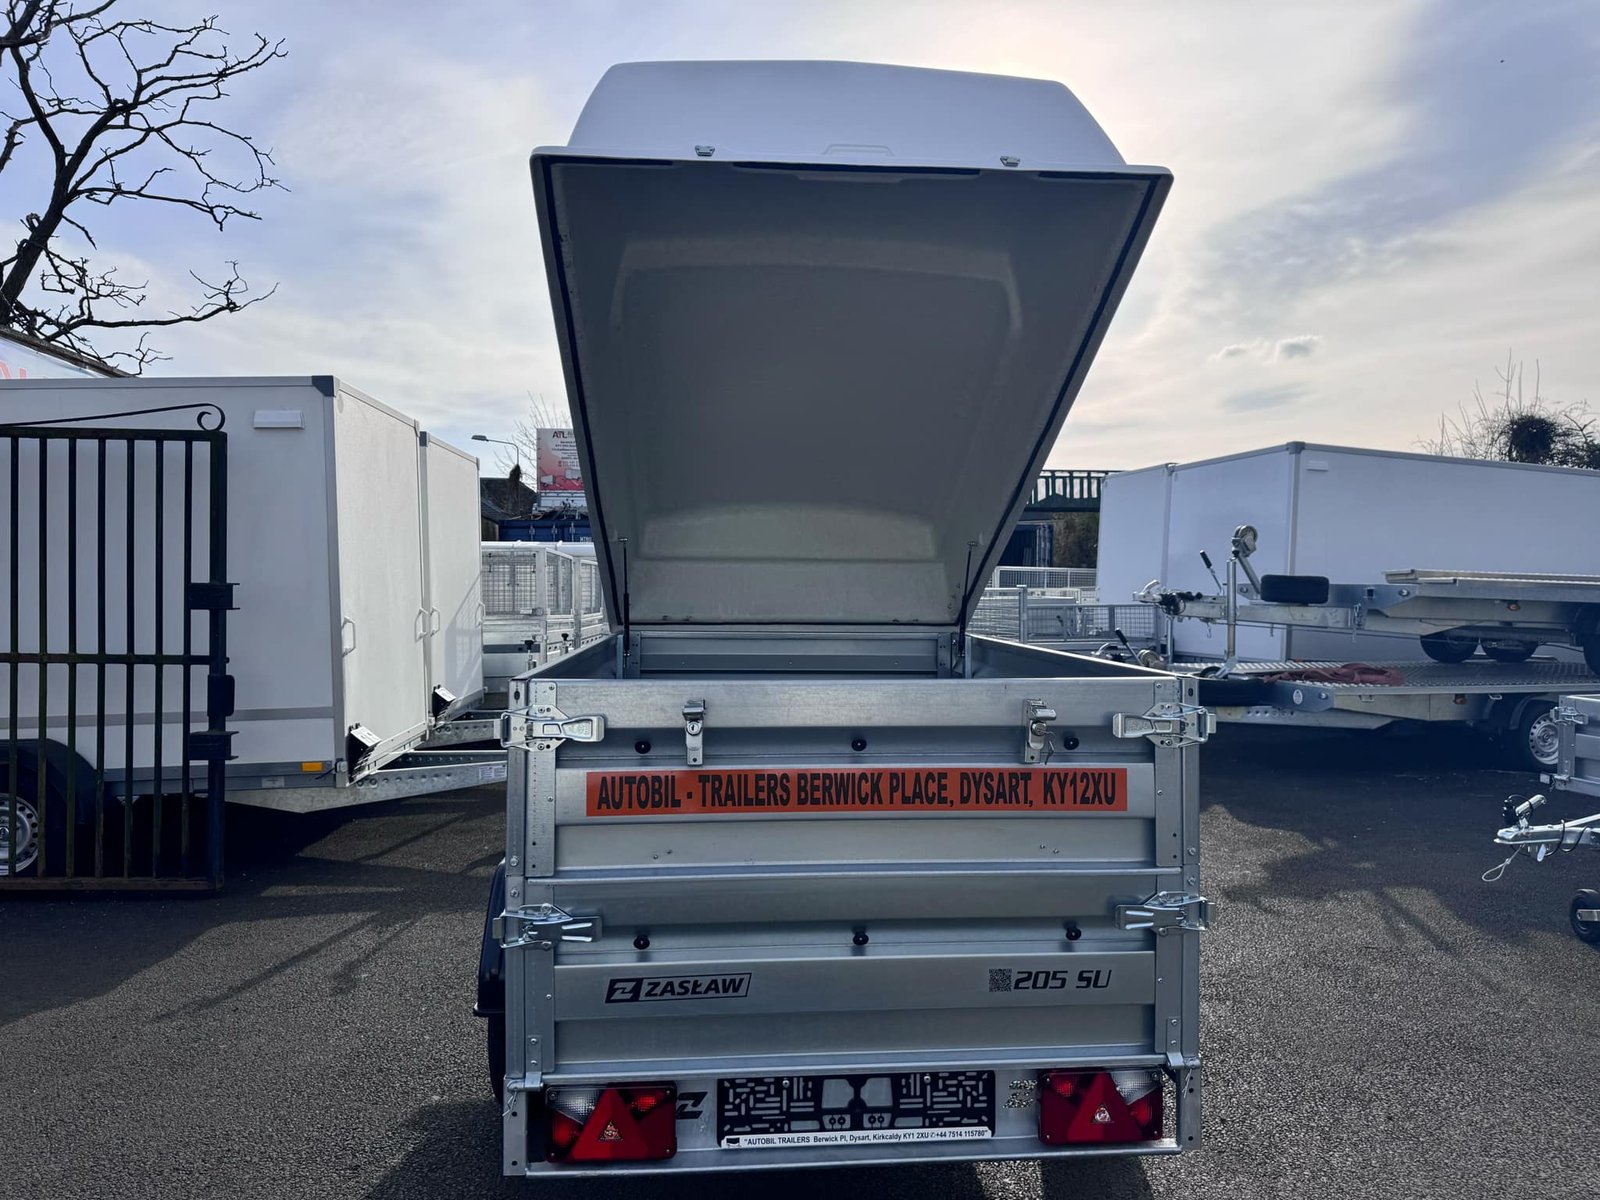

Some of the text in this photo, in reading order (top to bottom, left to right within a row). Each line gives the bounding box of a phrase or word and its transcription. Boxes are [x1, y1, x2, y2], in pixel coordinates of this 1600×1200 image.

[597, 775, 681, 810] AUTOBIL
[699, 773, 791, 807] TRAILERS
[797, 772, 884, 806] BERWICK
[889, 772, 954, 807] PLACE,
[960, 771, 1033, 807] DYSART,
[1044, 771, 1116, 805] KY12XU
[644, 978, 744, 997] ZASŁAW
[1014, 969, 1112, 990] 205 SU
[778, 1136, 810, 1144] TRAILERS
[813, 1135, 838, 1143] Berwick
[850, 1134, 871, 1142] Dysart,
[873, 1133, 901, 1141] Kirkcaldy
[948, 1130, 963, 1138] 7514
